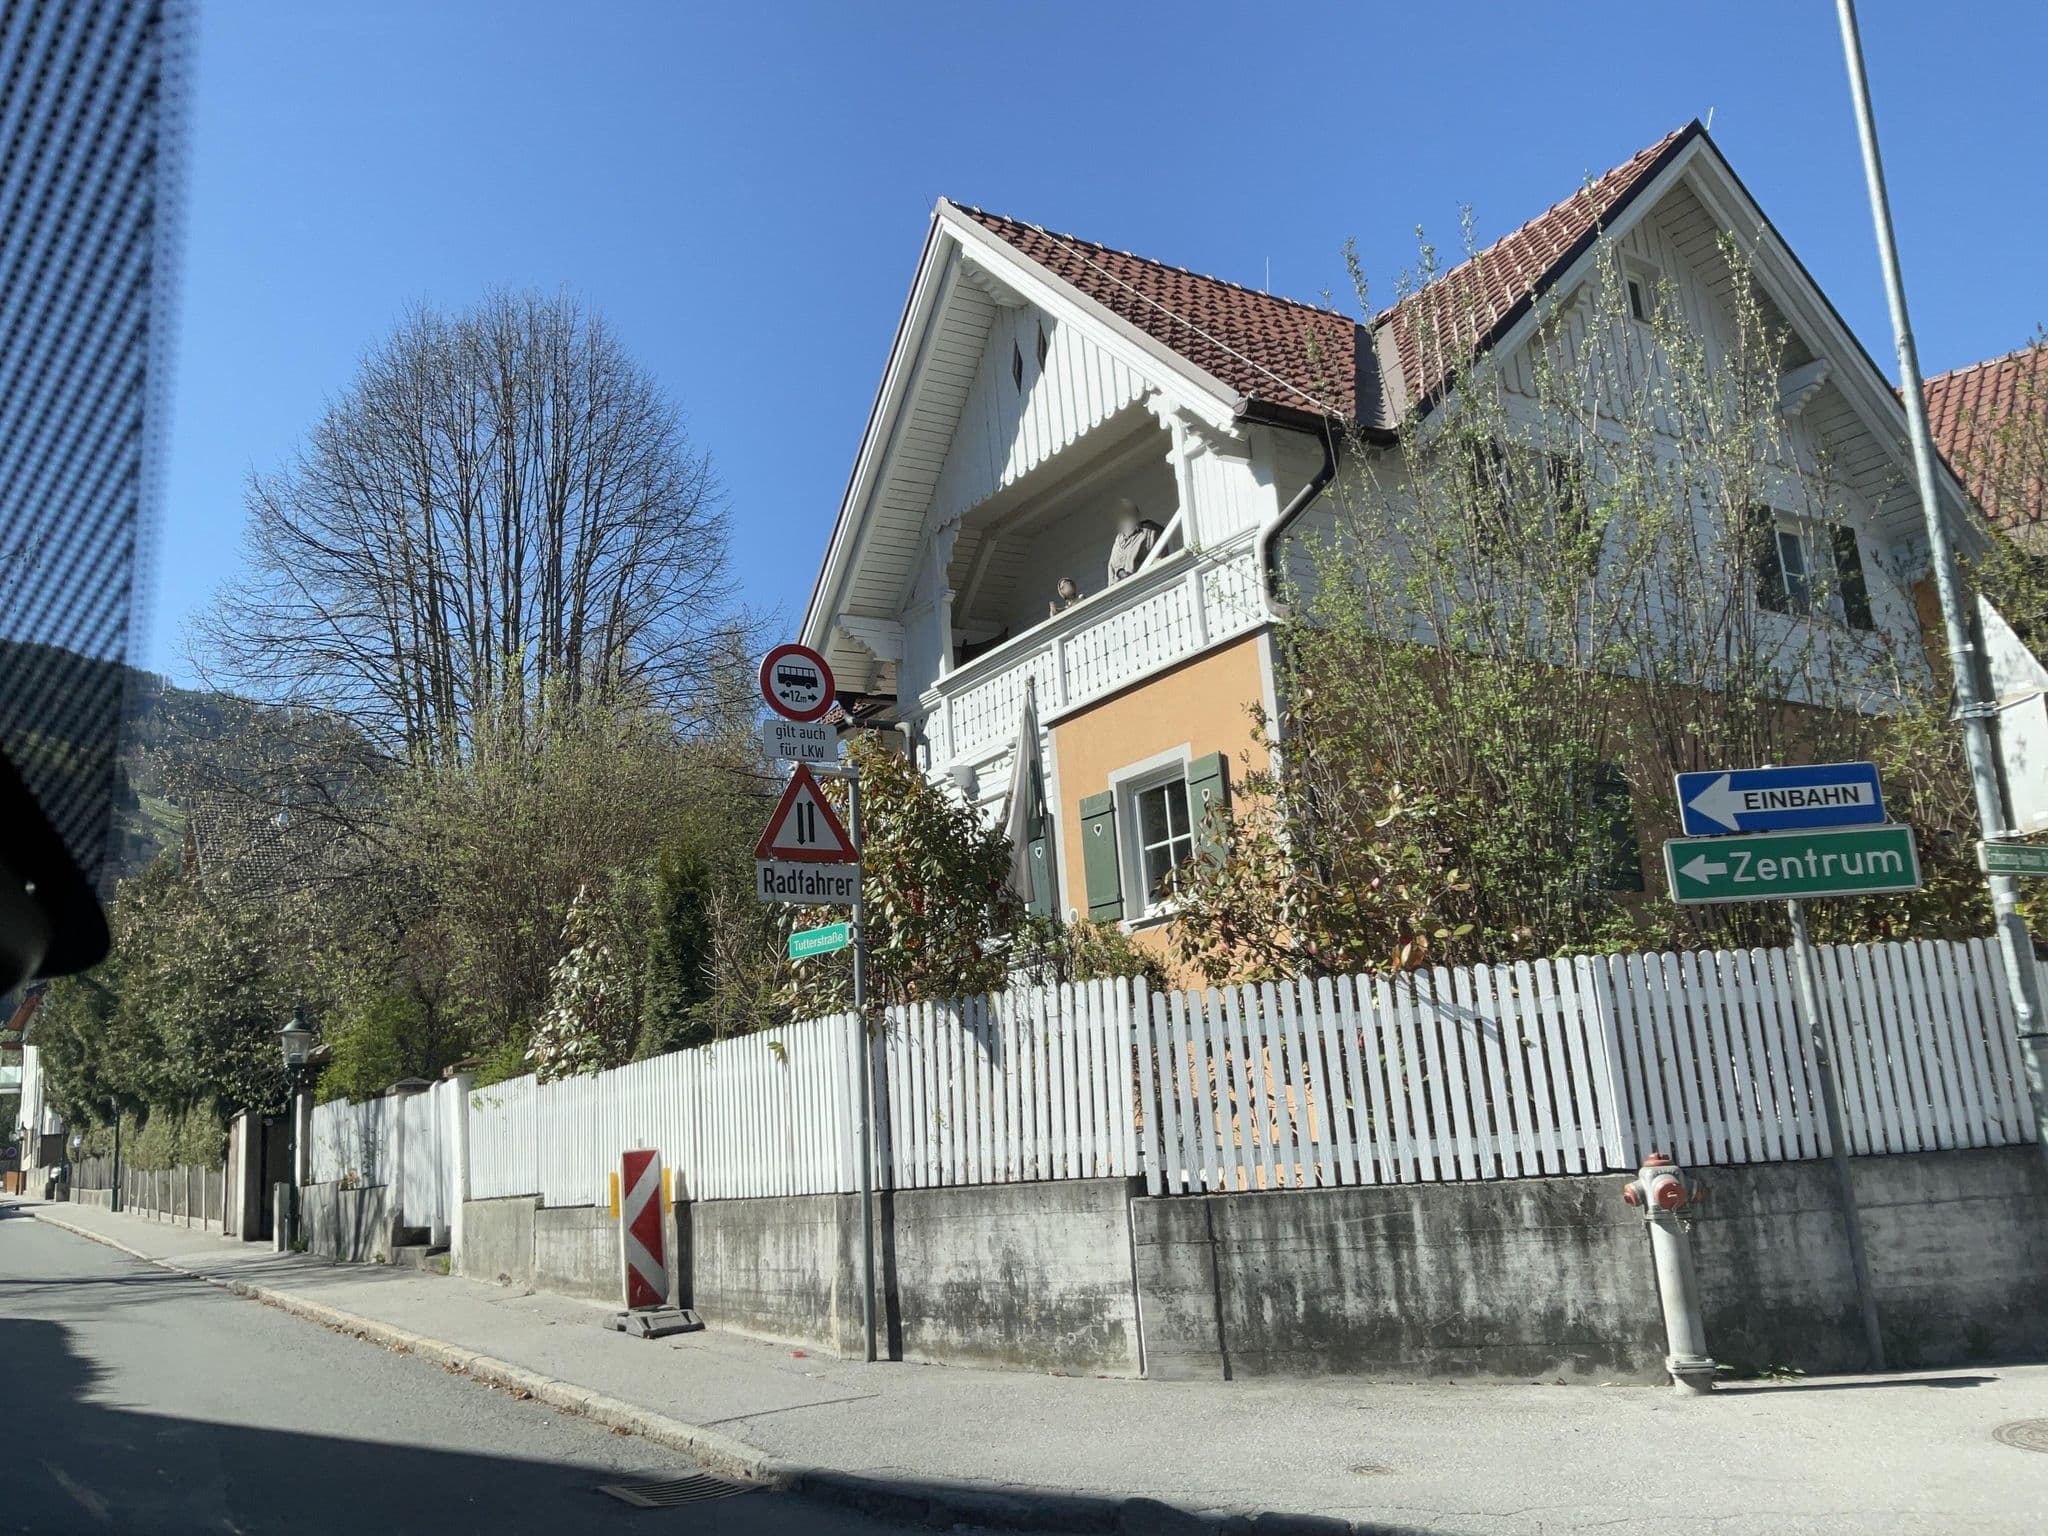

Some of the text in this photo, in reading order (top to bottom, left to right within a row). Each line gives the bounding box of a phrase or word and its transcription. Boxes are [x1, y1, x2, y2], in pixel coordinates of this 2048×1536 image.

[776, 725, 826, 740] gilt auch
[780, 743, 824, 758] für LKW
[1744, 786, 1860, 810] EINBAHN
[1729, 848, 1903, 882] Zentrum
[763, 867, 853, 896] Radfahrer
